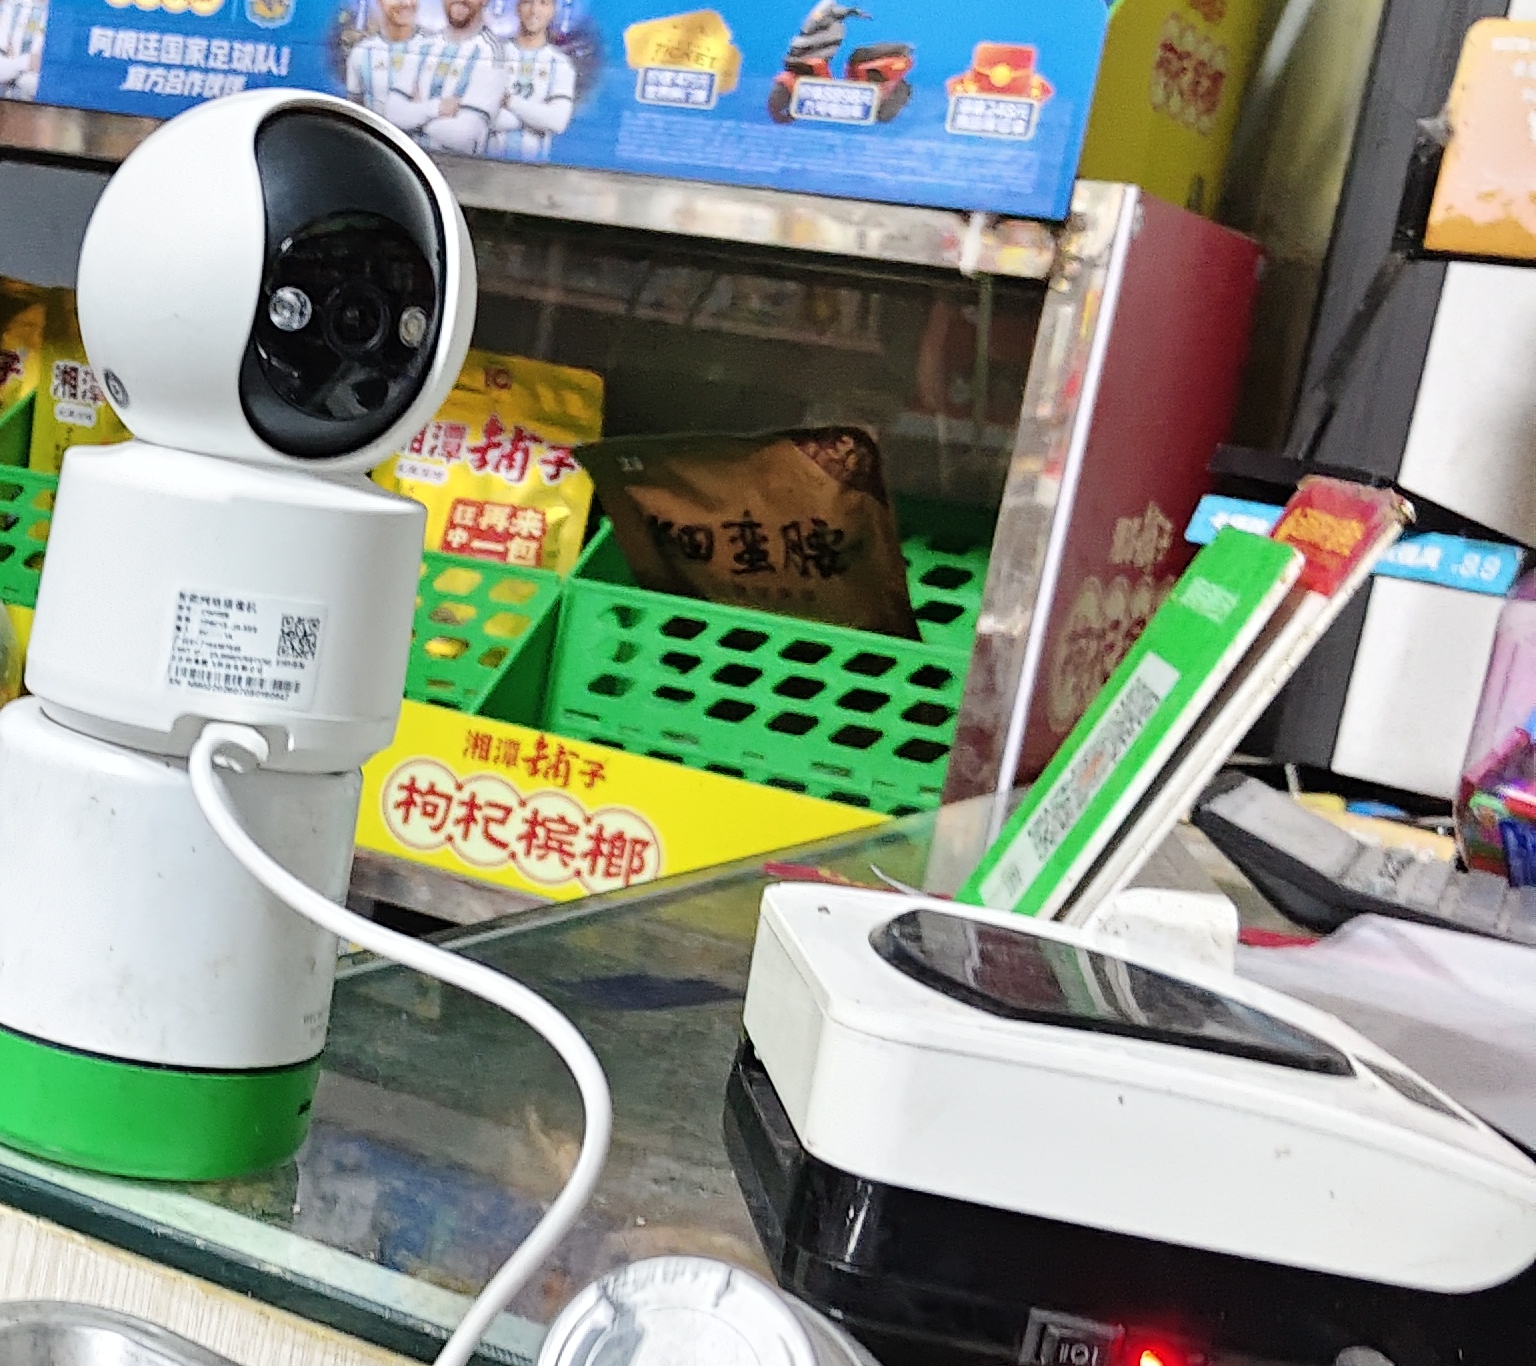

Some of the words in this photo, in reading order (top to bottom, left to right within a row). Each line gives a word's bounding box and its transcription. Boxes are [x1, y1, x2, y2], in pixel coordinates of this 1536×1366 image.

[464, 733, 608, 789] 湘潭铺子
[393, 775, 650, 888] 枸杞槟榔
